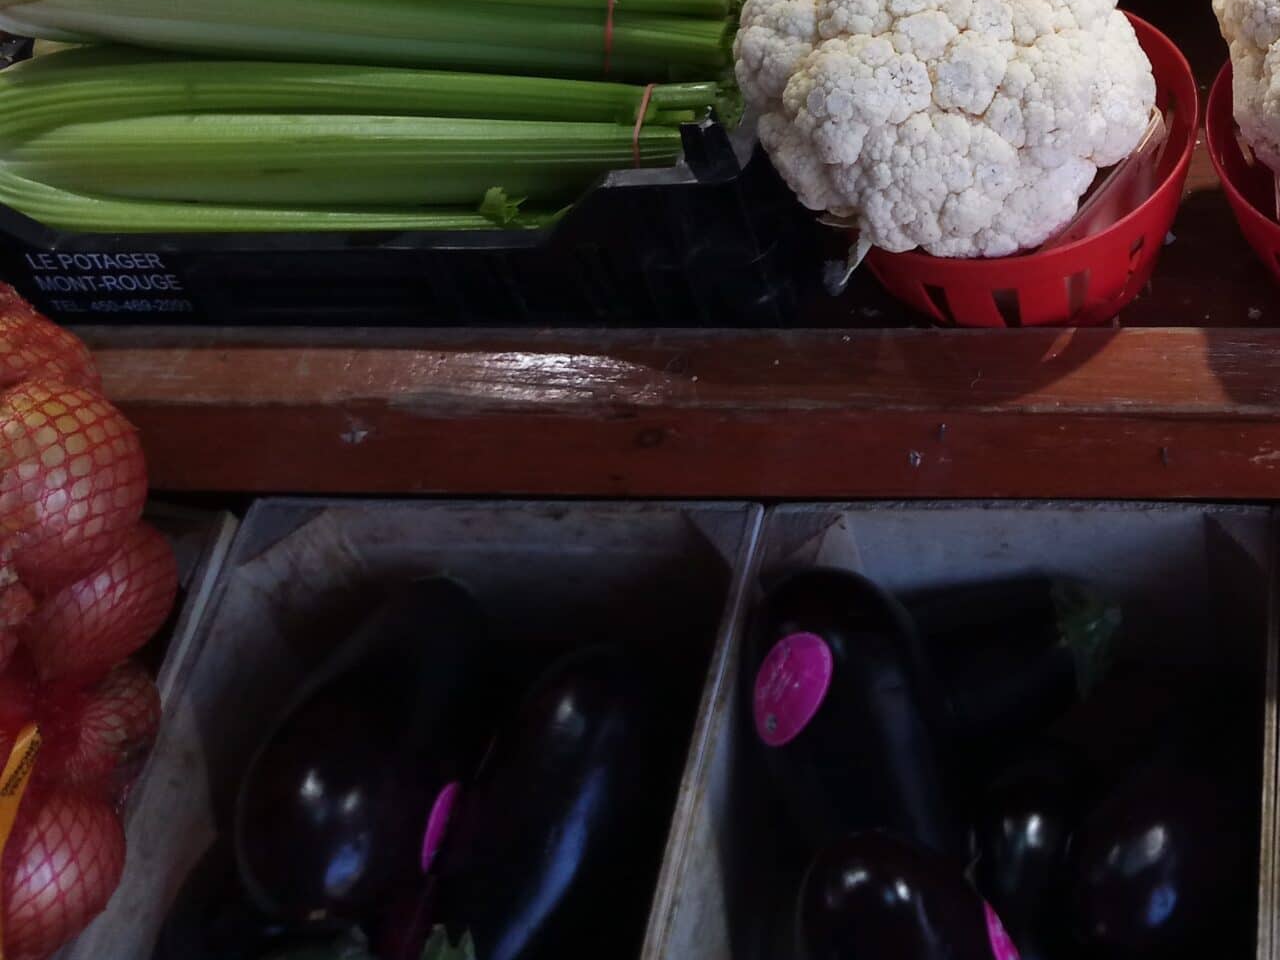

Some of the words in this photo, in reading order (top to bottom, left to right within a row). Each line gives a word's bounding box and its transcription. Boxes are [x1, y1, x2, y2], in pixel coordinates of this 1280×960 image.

[25, 252, 57, 271] LE
[57, 252, 166, 270] POTAGER
[33, 274, 185, 291] MONT-ROUGE
